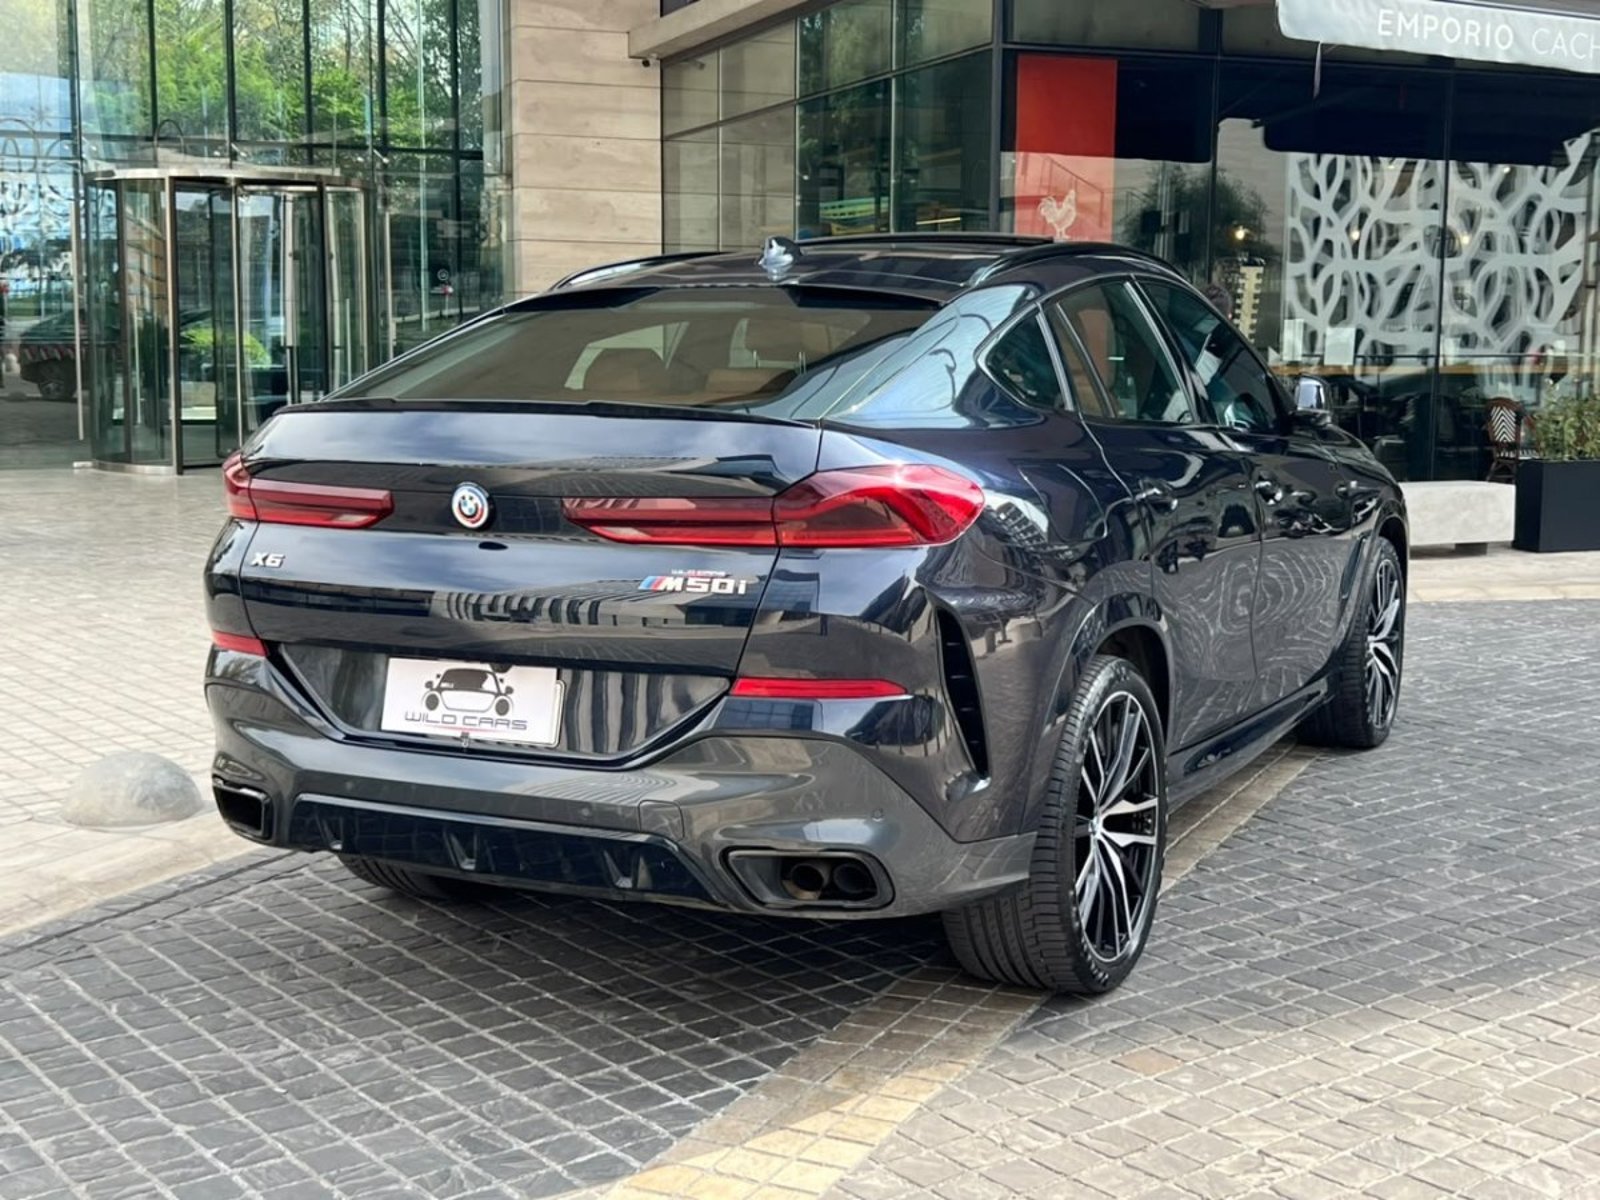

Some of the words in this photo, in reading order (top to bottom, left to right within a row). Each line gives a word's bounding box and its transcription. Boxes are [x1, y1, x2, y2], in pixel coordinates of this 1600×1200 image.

[1377, 9, 1514, 50] EMPORIO
[251, 552, 285, 567] X6
[656, 576, 747, 594] M50i
[405, 711, 457, 724] WILD
[462, 715, 528, 731] CARS
